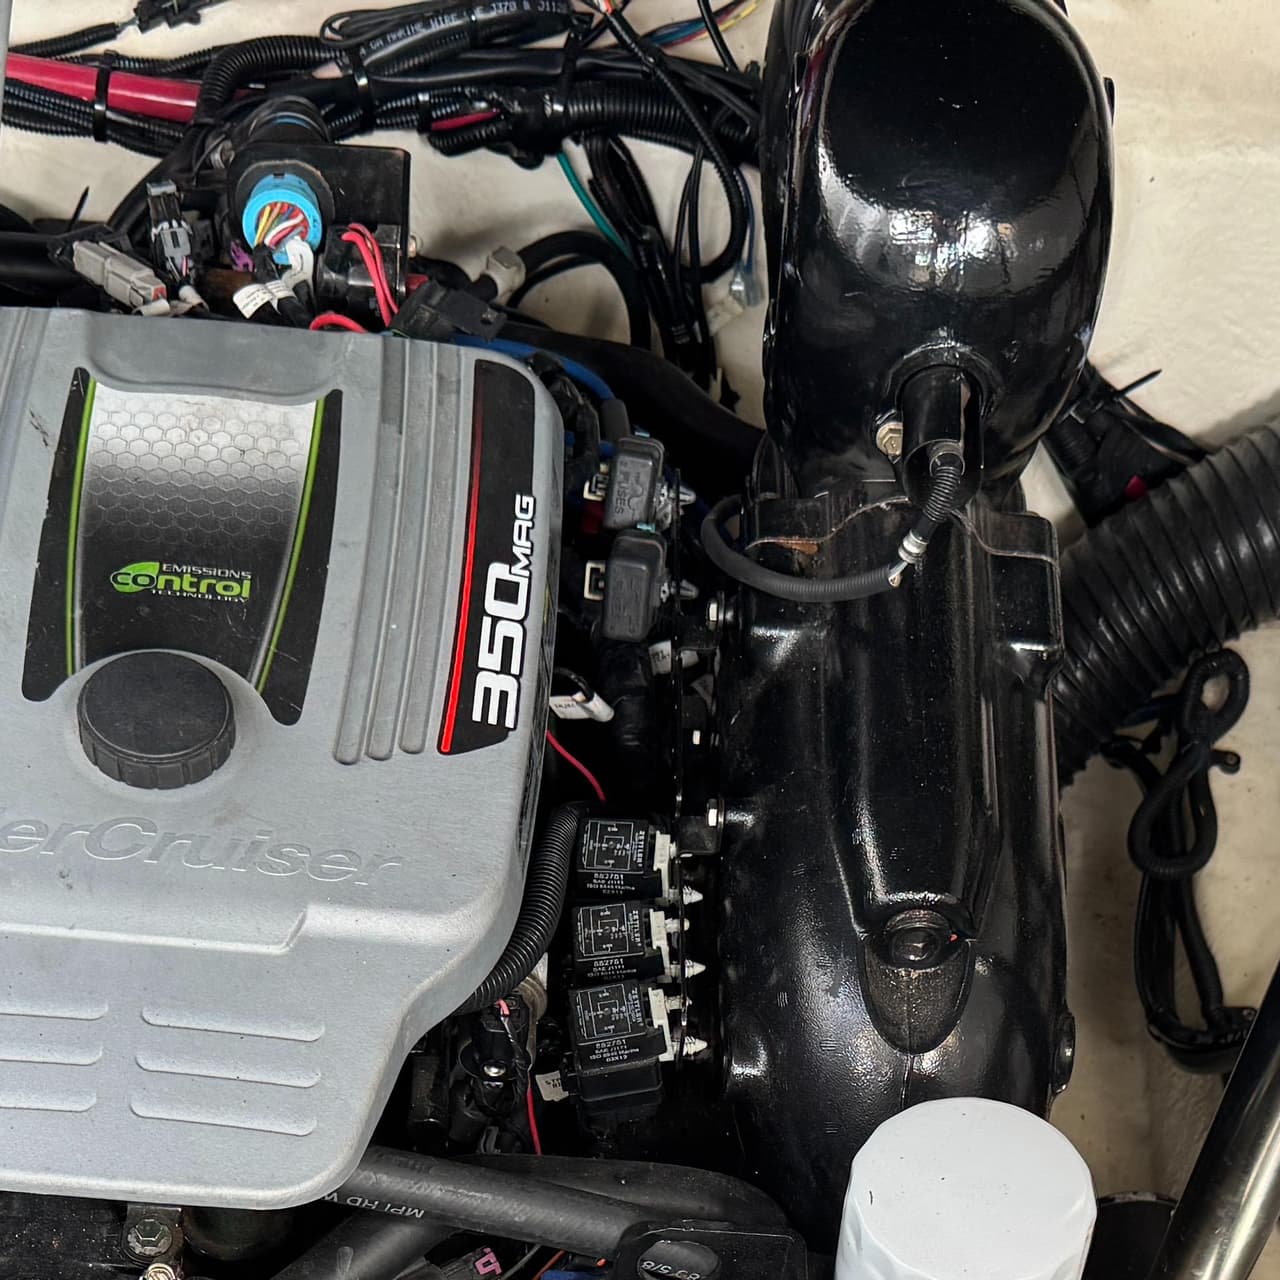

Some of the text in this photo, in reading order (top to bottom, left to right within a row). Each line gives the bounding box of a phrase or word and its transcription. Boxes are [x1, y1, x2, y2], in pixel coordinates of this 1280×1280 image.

[162, 563, 252, 579] EMISSIONS
[110, 571, 251, 598] control
[471, 494, 535, 730] 350 MAG
[344, 1194, 424, 1219] MPI HD
